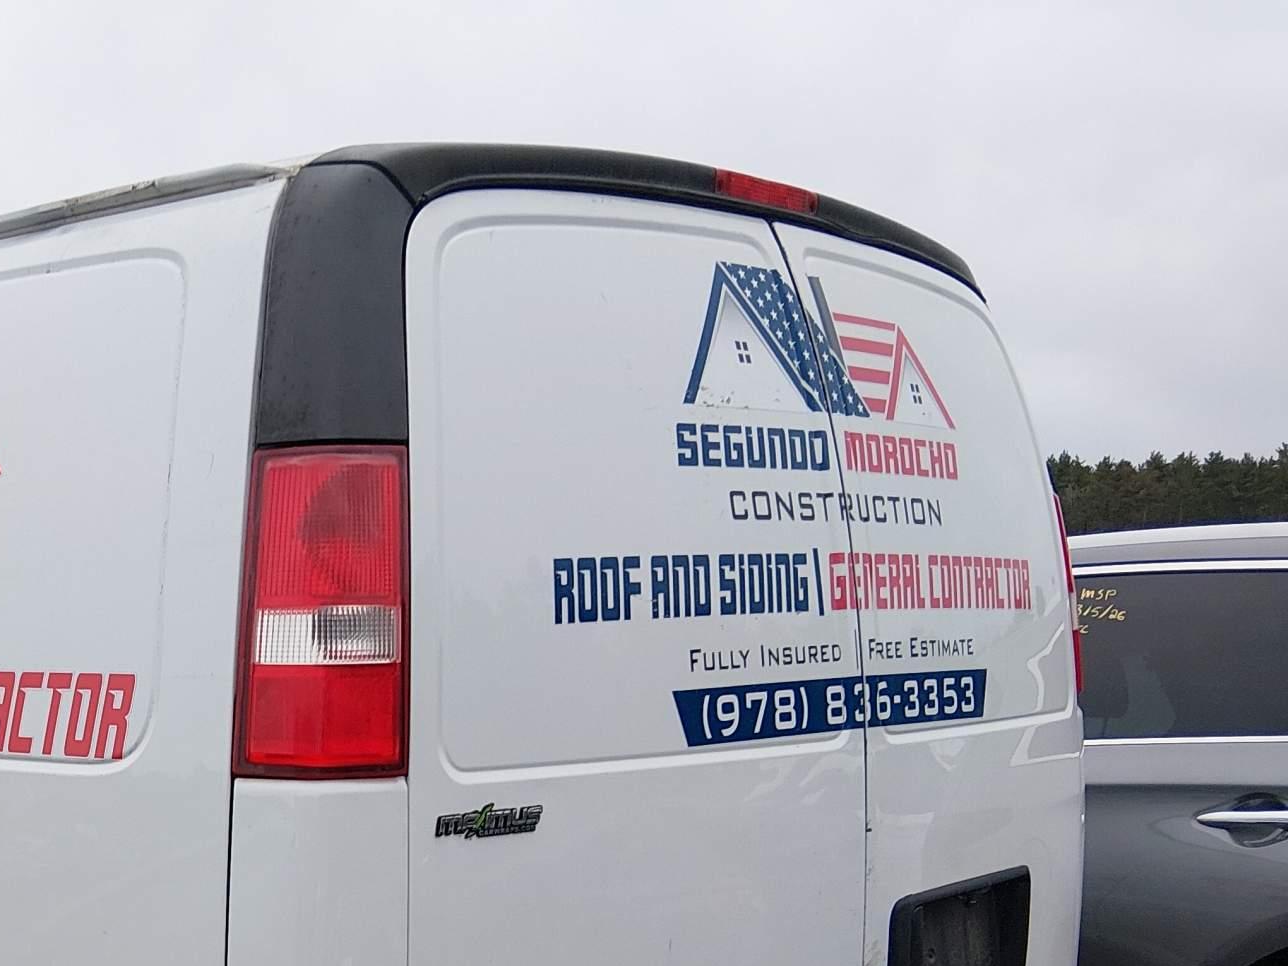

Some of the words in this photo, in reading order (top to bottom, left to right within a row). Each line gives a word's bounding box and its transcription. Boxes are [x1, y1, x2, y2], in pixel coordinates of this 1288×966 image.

[676, 422, 830, 472] SEGUNDO
[843, 430, 959, 481] MOROCHO
[728, 490, 943, 527] CONSTRUCTION
[553, 556, 642, 625] ROOF
[650, 554, 712, 620] AND
[718, 553, 810, 616] SIDING
[828, 552, 926, 612] GENERAL
[927, 554, 1033, 611] CONTRACTOR
[700, 687, 811, 739] (978)
[825, 675, 977, 726] 836-3353
